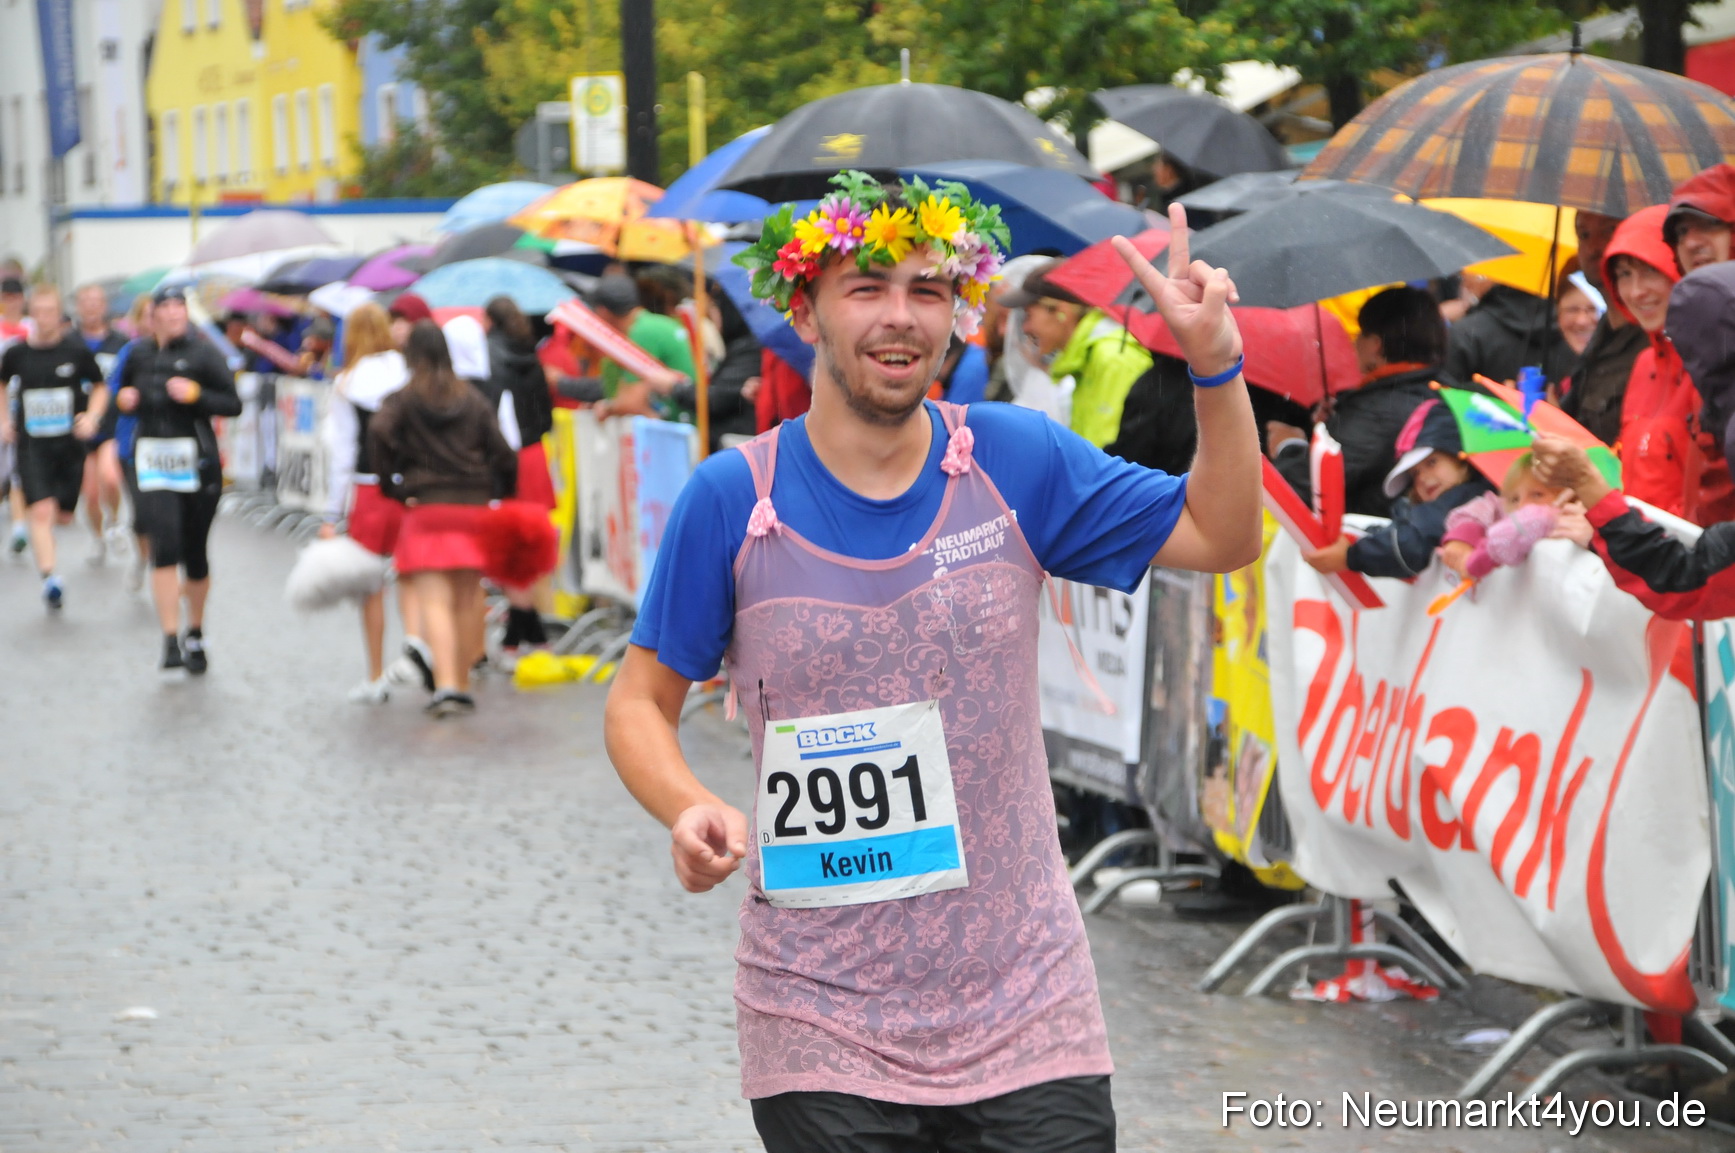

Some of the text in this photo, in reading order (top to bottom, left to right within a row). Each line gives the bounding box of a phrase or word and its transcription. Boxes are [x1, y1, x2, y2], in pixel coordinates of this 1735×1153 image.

[933, 531, 1006, 567] STADTLAUF
[797, 721, 877, 749] BOCK
[766, 753, 928, 838] 2991
[820, 846, 893, 879] Kevin
